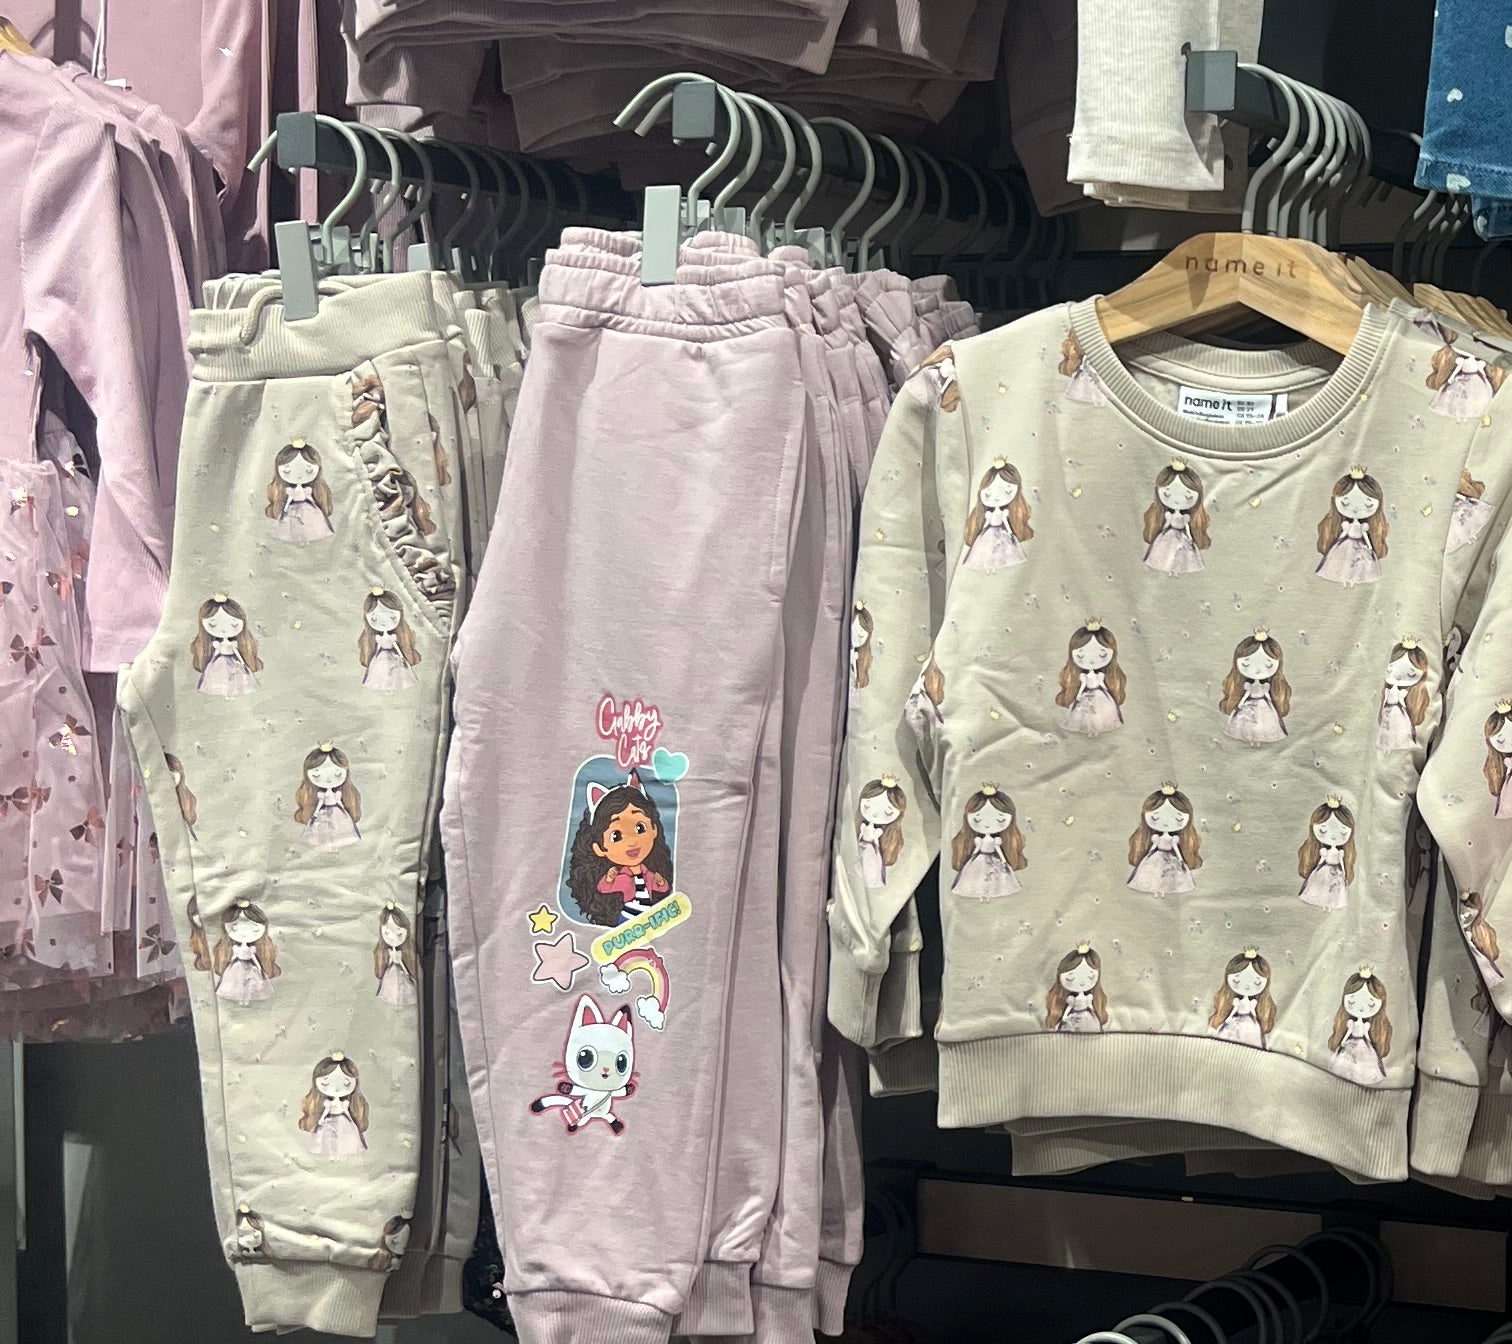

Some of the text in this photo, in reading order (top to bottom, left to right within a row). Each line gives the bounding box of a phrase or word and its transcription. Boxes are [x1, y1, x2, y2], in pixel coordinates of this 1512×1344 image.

[1185, 256, 1297, 279] name it
[1184, 396, 1220, 410] name
[599, 697, 661, 742] Gabby
[618, 733, 652, 768] Cats
